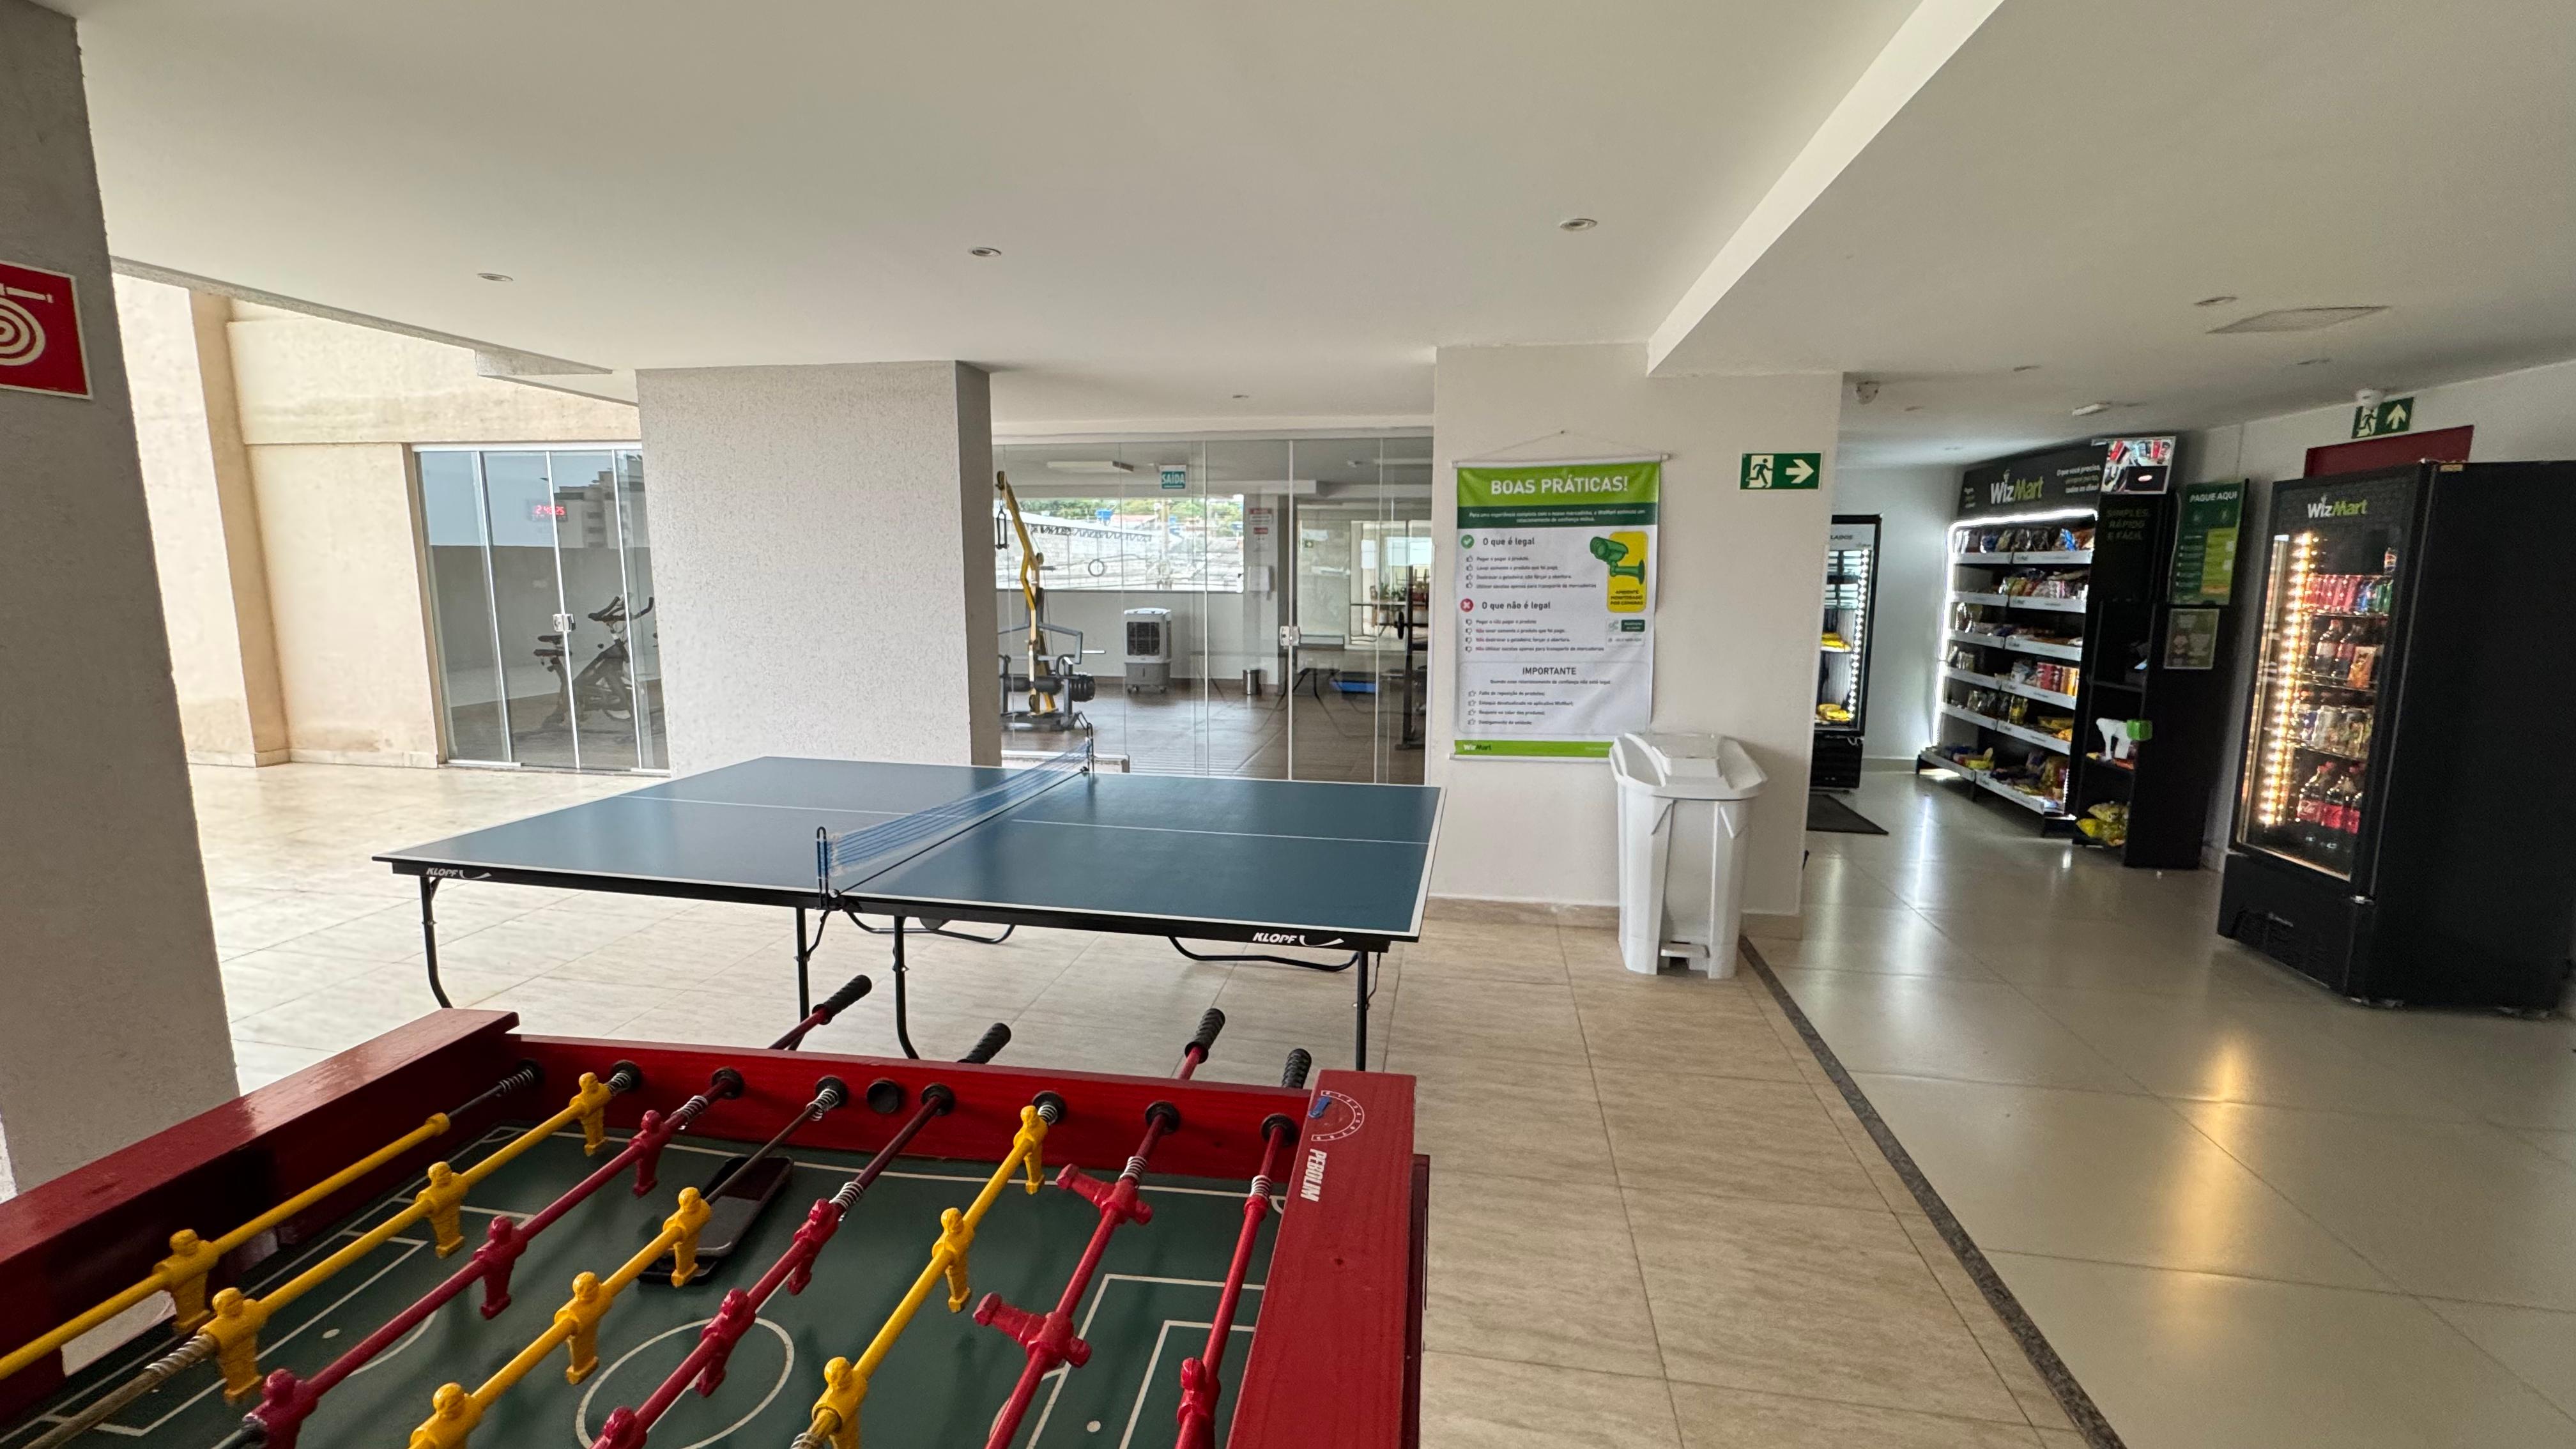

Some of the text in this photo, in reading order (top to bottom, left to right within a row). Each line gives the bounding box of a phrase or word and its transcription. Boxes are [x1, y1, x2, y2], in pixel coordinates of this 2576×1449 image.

[1162, 471, 1184, 484] SAÍDA
[1491, 475, 1629, 494] BOAS PRÁTICAS!
[1990, 475, 2044, 505] WizMart
[2189, 490, 2238, 503] PAGUE AQUI
[2307, 498, 2368, 519] WizMart
[1508, 536, 1513, 545] é
[1515, 537, 1535, 547] legal
[1482, 601, 1551, 611] O que não é legal
[1522, 666, 1577, 675] IMPORTANTE
[425, 867, 459, 877] KLOPF
[1252, 931, 1298, 944] KLOPF
[1300, 1148, 1328, 1202] PEBOLIM
